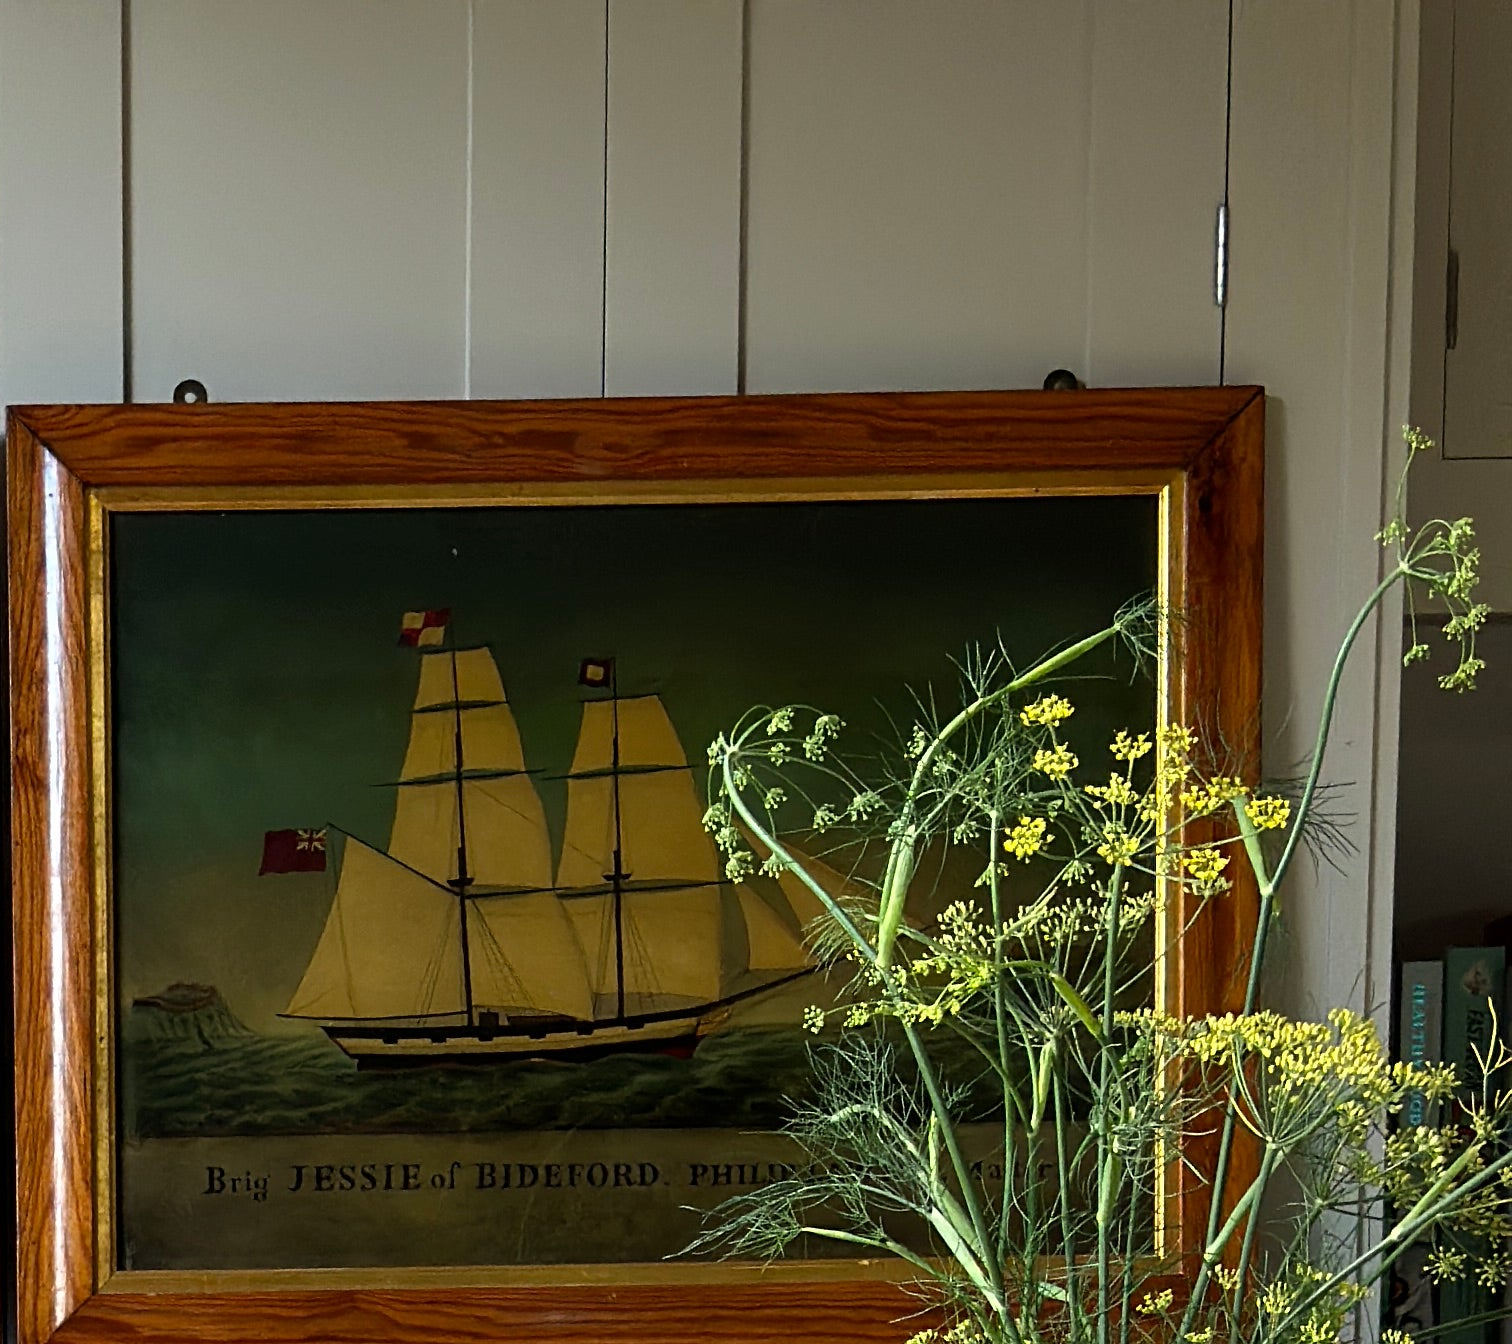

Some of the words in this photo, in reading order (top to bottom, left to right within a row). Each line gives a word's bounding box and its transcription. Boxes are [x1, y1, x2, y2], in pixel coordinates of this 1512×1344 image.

[202, 1165, 270, 1201] Brig
[287, 1162, 423, 1193] JESSIE
[429, 1160, 462, 1190] of
